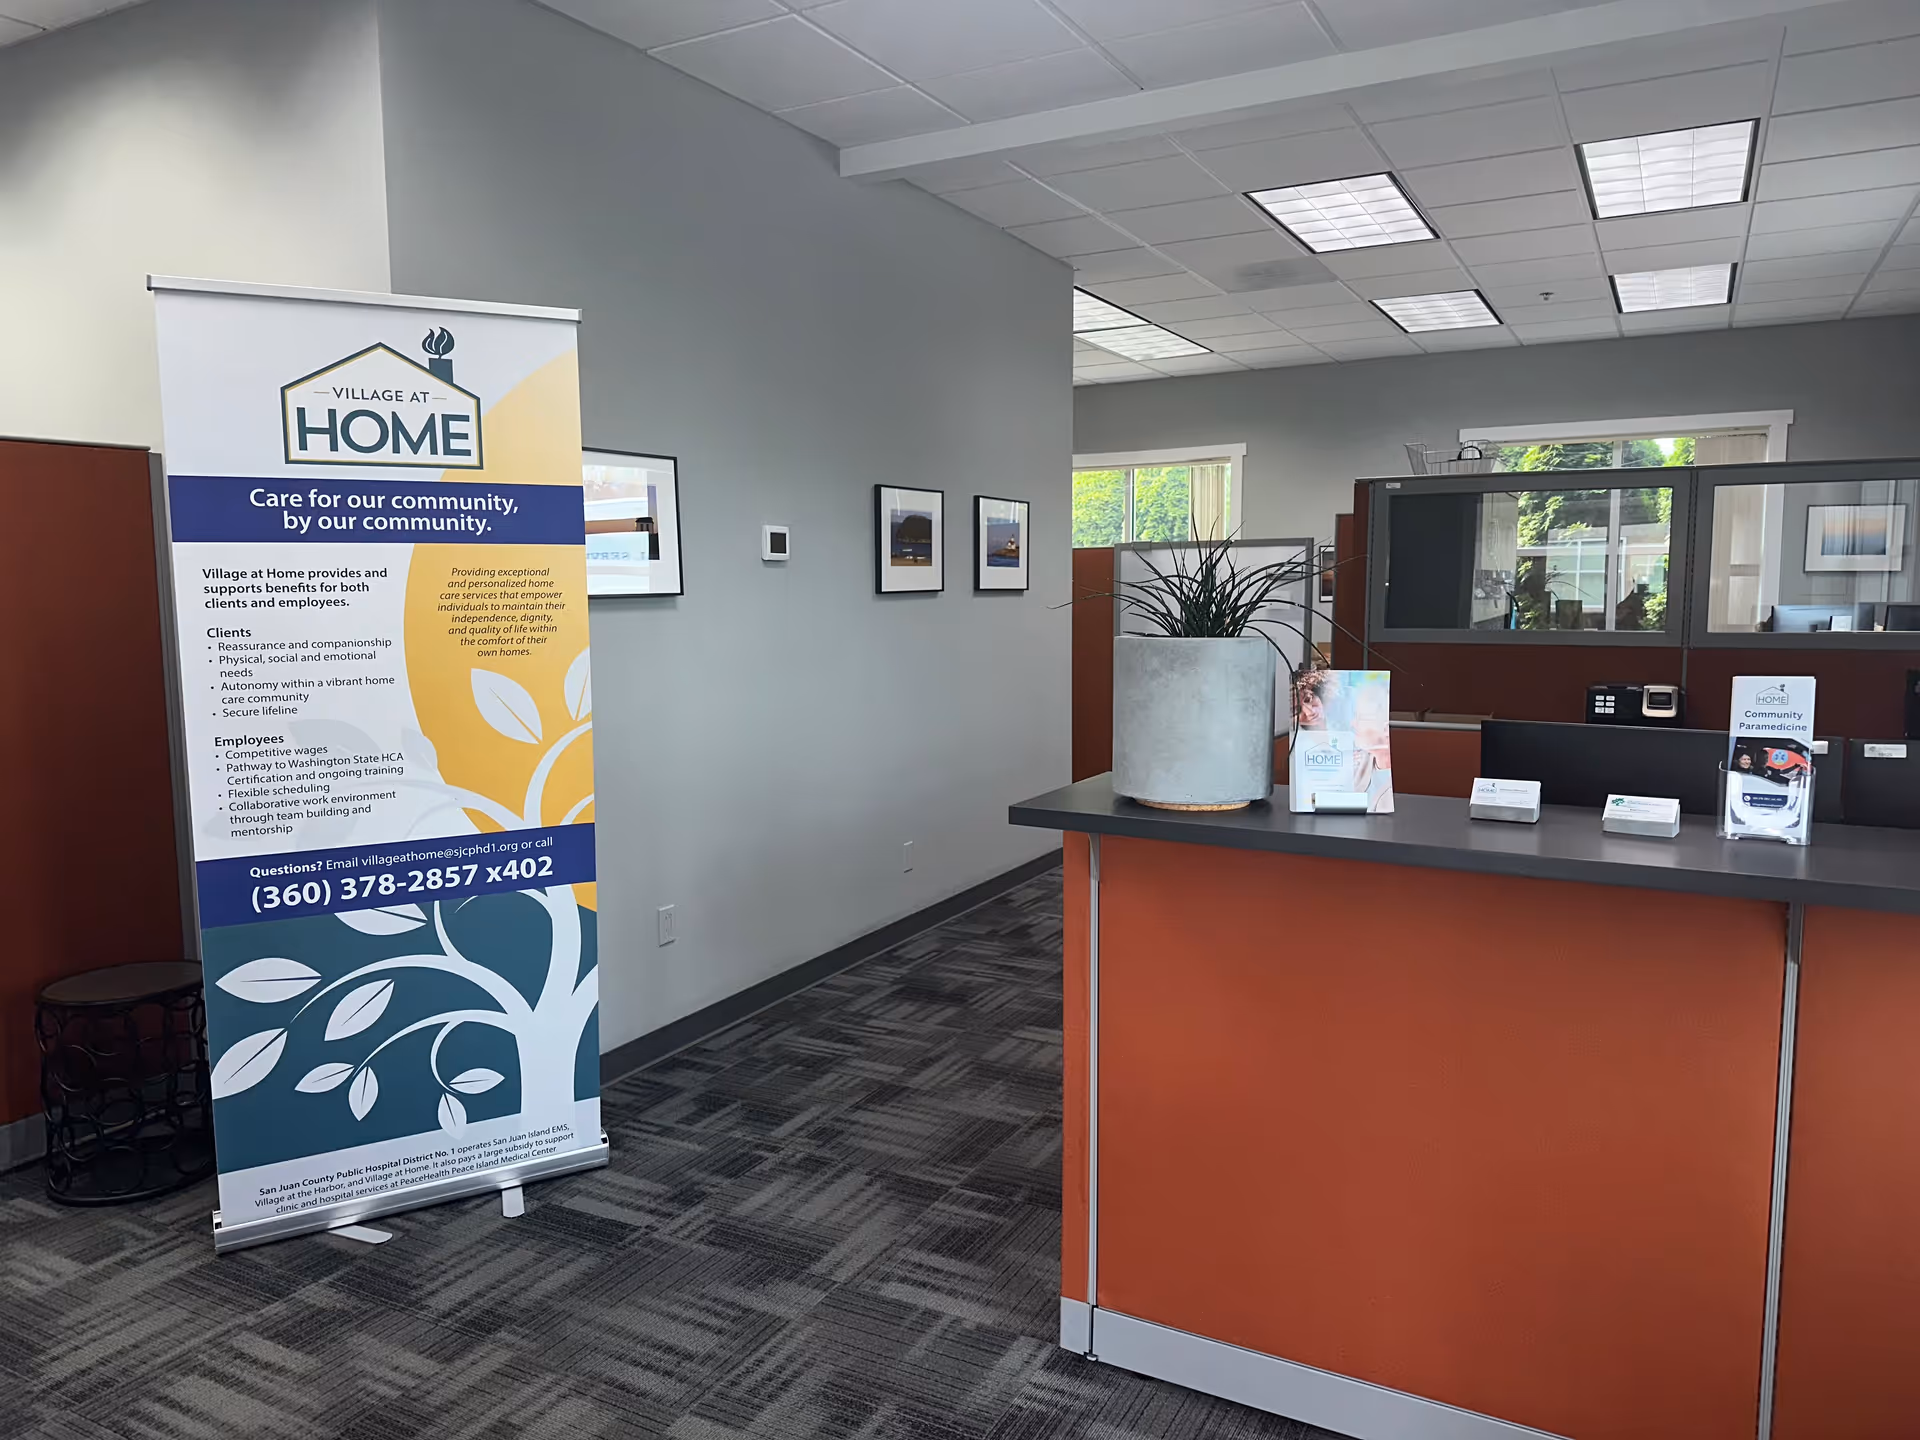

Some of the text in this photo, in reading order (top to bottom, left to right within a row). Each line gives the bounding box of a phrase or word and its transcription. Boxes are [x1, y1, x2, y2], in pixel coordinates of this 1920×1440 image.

[332, 386, 430, 403] VILLAGE AT
[296, 406, 471, 456] HOME
[249, 488, 518, 516] Care for our community,
[283, 510, 491, 535] by our community.
[201, 567, 387, 581] Village at Home provides and
[451, 567, 549, 578] Providing exceptional
[203, 581, 369, 596] supports benefits for both
[447, 578, 554, 590] and personalized home
[439, 592, 460, 600] care
[499, 590, 519, 599] that
[520, 591, 562, 600] empower
[204, 596, 349, 609] clients and employees.
[437, 601, 565, 611] individuals to maintain their
[451, 613, 553, 624] independence, dignity,
[206, 627, 251, 638] Clients
[447, 624, 557, 636] and quality of life within
[217, 637, 392, 651] Reassurance and companionship
[460, 635, 547, 646] the comfort of their
[218, 650, 376, 667] Physical, social and emotional
[476, 647, 531, 657] own homes.
[219, 667, 253, 678] needs
[220, 681, 278, 691] Autonomy
[280, 678, 314, 688] within
[325, 677, 362, 686] vibrant
[365, 676, 394, 685] home
[221, 693, 309, 704] care community
[1757, 695, 1786, 704] HOME
[222, 705, 297, 717] Secure lifeline
[1744, 710, 1803, 720] Community
[1738, 722, 1807, 731] Paramedicine
[214, 734, 284, 748] Employees
[225, 746, 328, 760] Competitive wages
[1306, 754, 1340, 764] HOME
[226, 752, 404, 772] Pathway to Washington State HCA
[226, 765, 403, 785] Certification and ongoing training
[228, 783, 330, 798] Flexible scheduling
[228, 790, 396, 811] Collaborative work environment
[229, 803, 371, 824] through team building and
[230, 824, 293, 837] mentorship
[249, 836, 552, 878] Questions? Email villageathome@sjcphd1.org or call
[251, 855, 553, 913] (360) 378-2857 x402
[259, 1123, 569, 1196] San Juan County Public Hospital District No. 1 operates San Juan Island EMS,
[254, 1195, 285, 1207] Village
[286, 1192, 295, 1201] at
[296, 1189, 312, 1198] the
[313, 1182, 345, 1194] Harbor,
[347, 1176, 363, 1187] and
[364, 1172, 393, 1183] Village
[394, 1169, 403, 1177] at
[403, 1164, 431, 1176] Home.
[440, 1158, 456, 1167] also
[457, 1154, 476, 1165] pays
[483, 1148, 503, 1159] large
[504, 1140, 534, 1153] subsidy
[544, 1132, 574, 1144] support
[275, 1203, 298, 1213] clinic
[300, 1198, 317, 1208] and
[319, 1190, 353, 1206] hospital
[355, 1183, 388, 1196] services
[390, 1180, 399, 1188] at
[400, 1167, 450, 1185] PeaceHealth
[451, 1165, 474, 1174] Peace
[476, 1158, 499, 1169] Island
[500, 1151, 530, 1164] Medical
